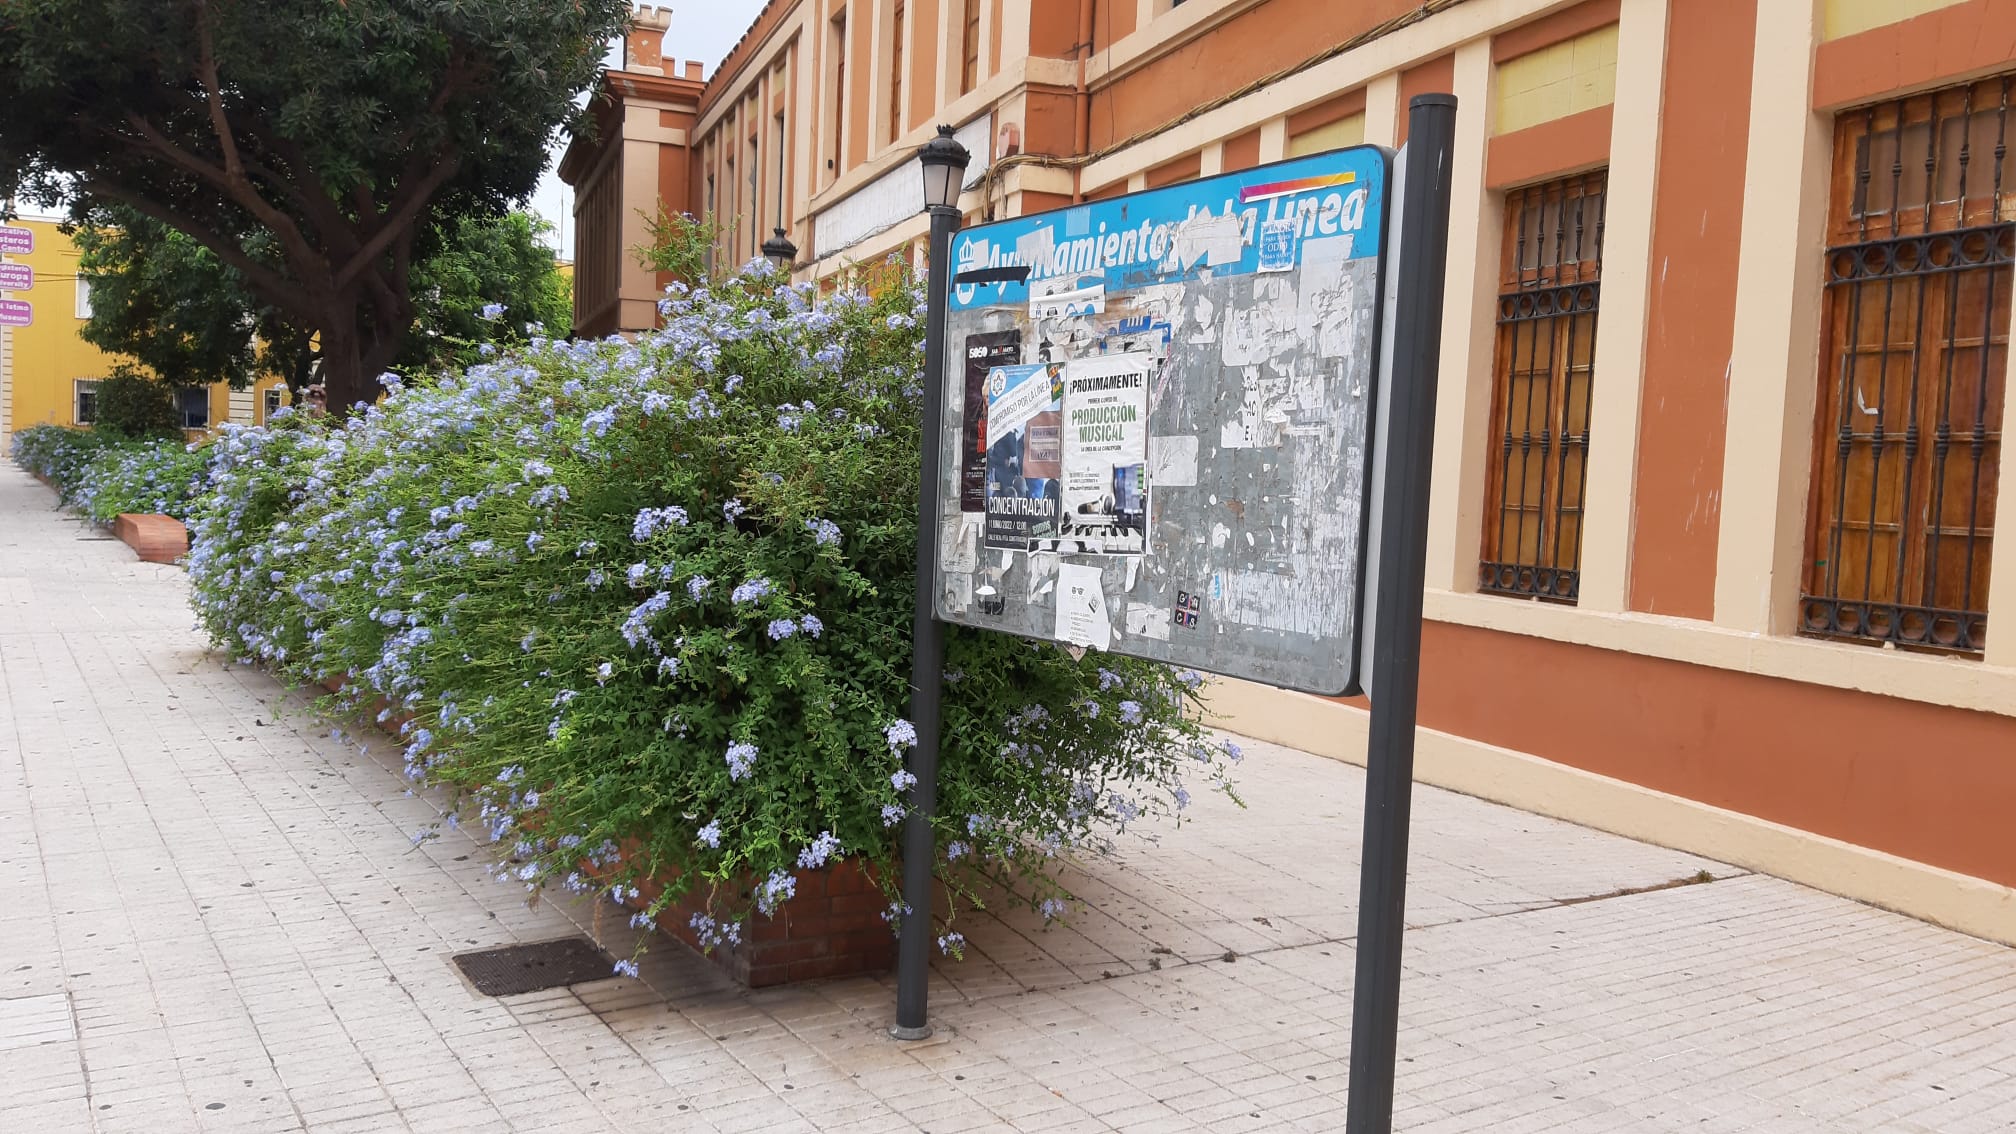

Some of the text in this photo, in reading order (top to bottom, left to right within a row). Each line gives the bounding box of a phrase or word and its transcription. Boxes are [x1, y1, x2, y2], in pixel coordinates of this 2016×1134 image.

[1069, 373, 1142, 396] ¡PRÓXIMAMENTE!
[1072, 402, 1136, 426] PRODUCCIÓN
[1079, 424, 1124, 443] MUSICAL
[988, 494, 1055, 516] CONCENTRACIÓN
